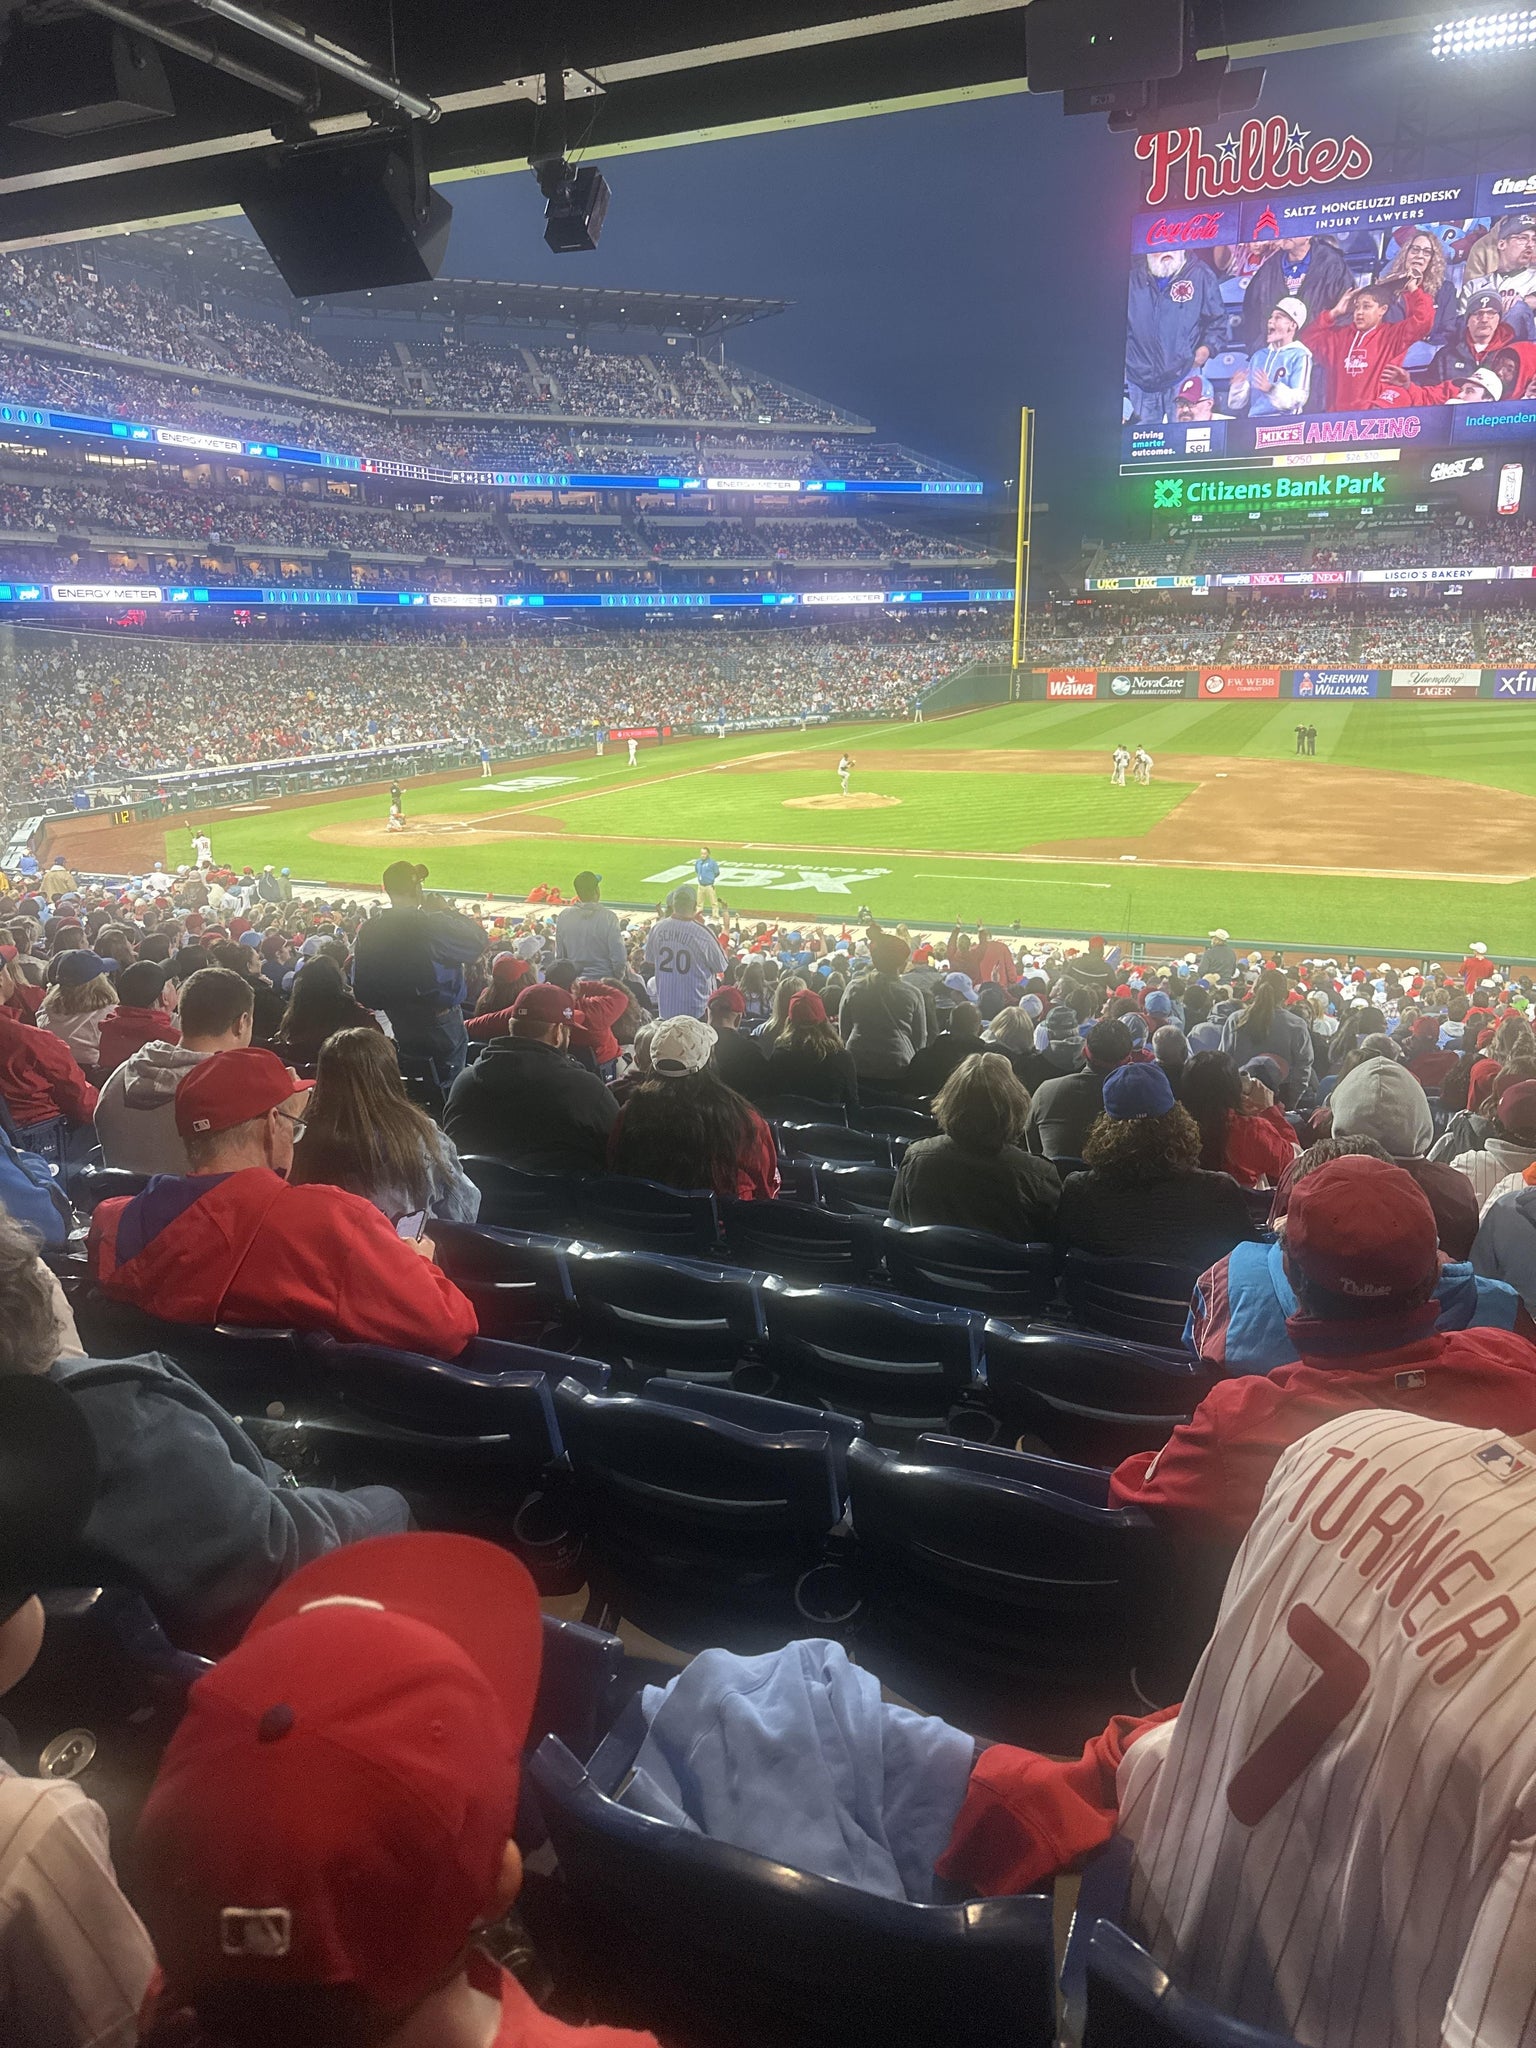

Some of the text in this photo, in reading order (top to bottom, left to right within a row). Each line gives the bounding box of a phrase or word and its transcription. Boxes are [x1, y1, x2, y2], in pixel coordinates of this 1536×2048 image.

[1134, 115, 1373, 205] Phillies
[1283, 188, 1462, 219] SALTZ MONGELUZZI BENDESKY
[1315, 208, 1425, 229] INJURY LAWYERS
[1132, 431, 1164, 440] Driving
[1261, 428, 1300, 443] MIKE'S
[1306, 416, 1421, 444] AMAZING
[1132, 440, 1166, 448] smarter
[1186, 472, 1387, 502] Citizens Bank Park
[1253, 574, 1283, 584] NECA
[1316, 573, 1345, 583] NECA
[1431, 570, 1474, 578] BAKERY
[58, 588, 158, 599] ENERGY METER
[1131, 676, 1184, 689] NovaCare
[1246, 677, 1275, 686] WEBB
[1316, 672, 1369, 684] SHERWIN
[1408, 671, 1464, 684] Yuengling
[1499, 671, 1536, 695] xfi
[1050, 681, 1094, 696] Wawa
[1131, 688, 1182, 696] REHABILITATION
[1416, 687, 1452, 696] LAGER
[659, 946, 691, 975] 20
[1288, 1445, 1521, 1686] TURNER
[1226, 1601, 1371, 1828] 7
